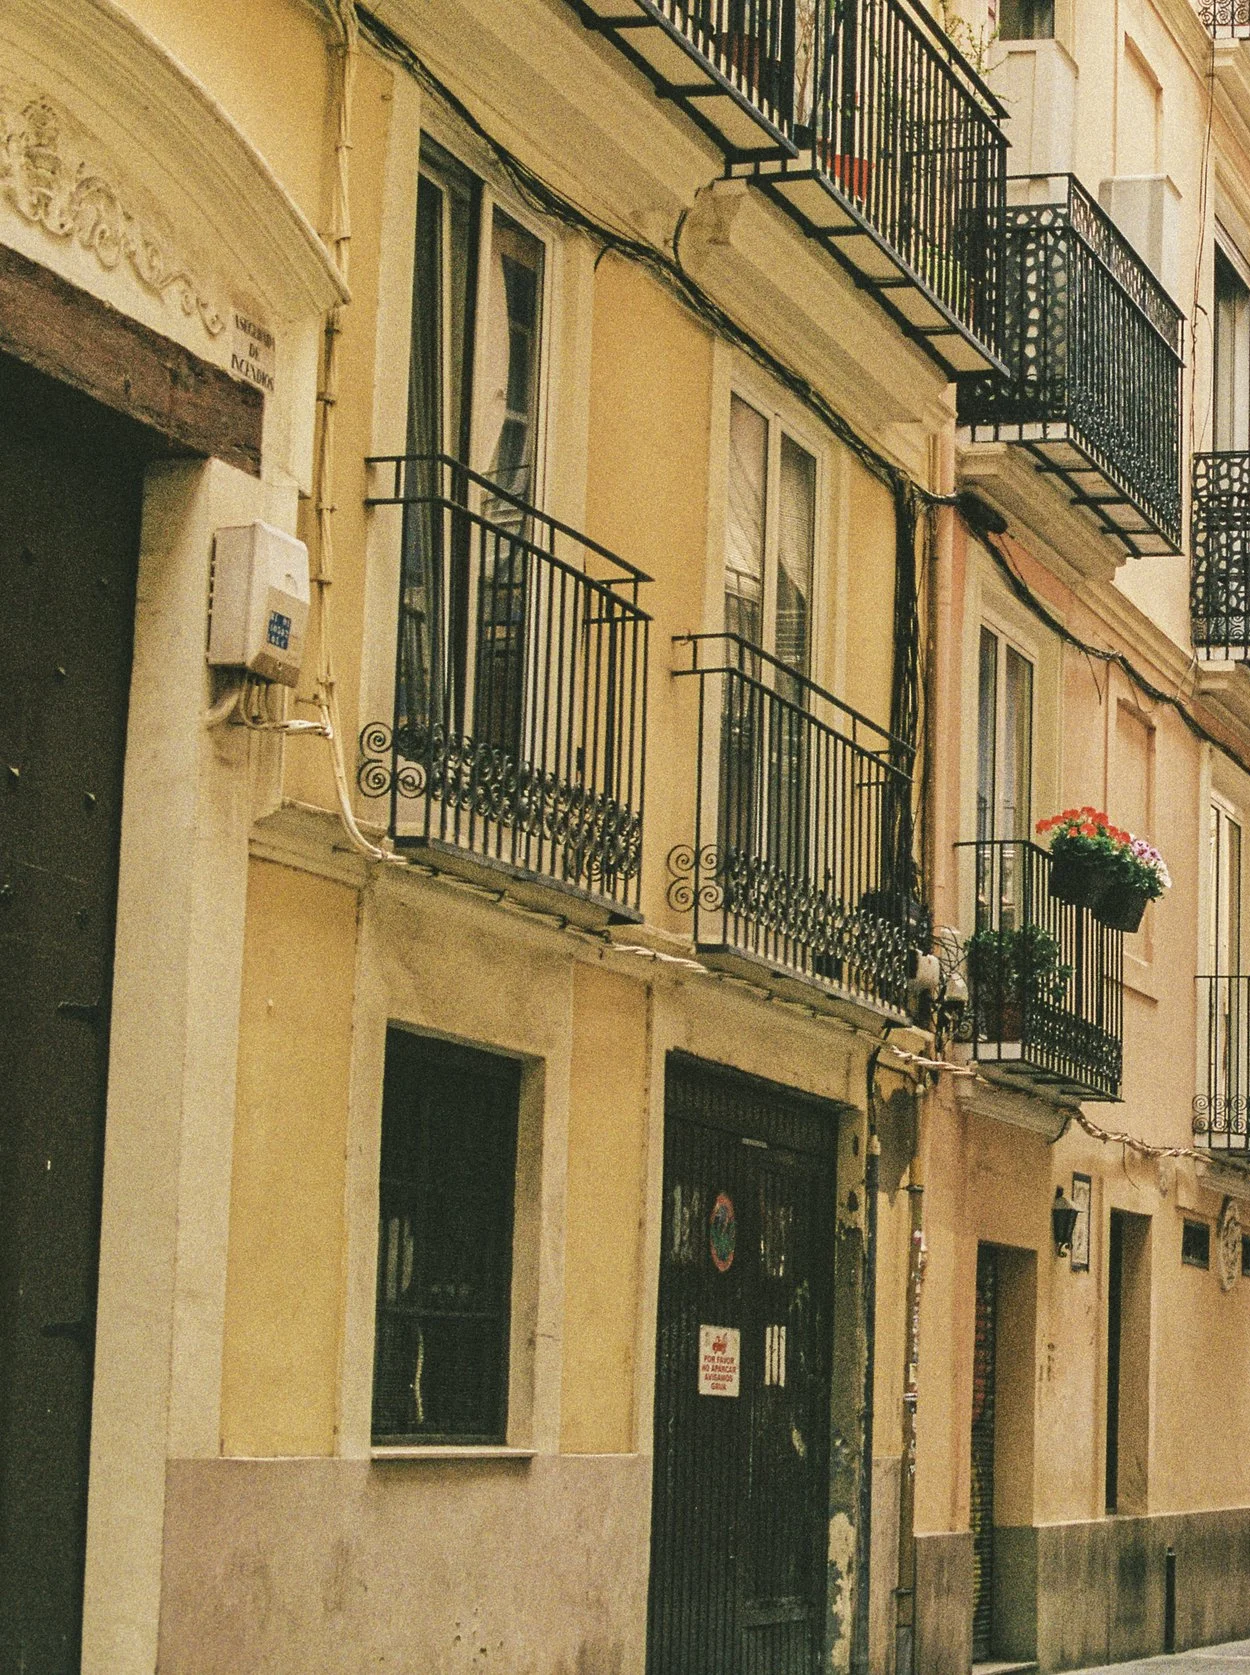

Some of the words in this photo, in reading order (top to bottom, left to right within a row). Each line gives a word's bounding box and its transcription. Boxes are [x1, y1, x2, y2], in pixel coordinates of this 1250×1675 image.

[704, 1355, 716, 1363] POR
[717, 1356, 735, 1364] FAVOR
[701, 1364, 710, 1372] NO
[711, 1365, 737, 1373] APARCAR
[704, 1374, 733, 1383] AVISAMOS
